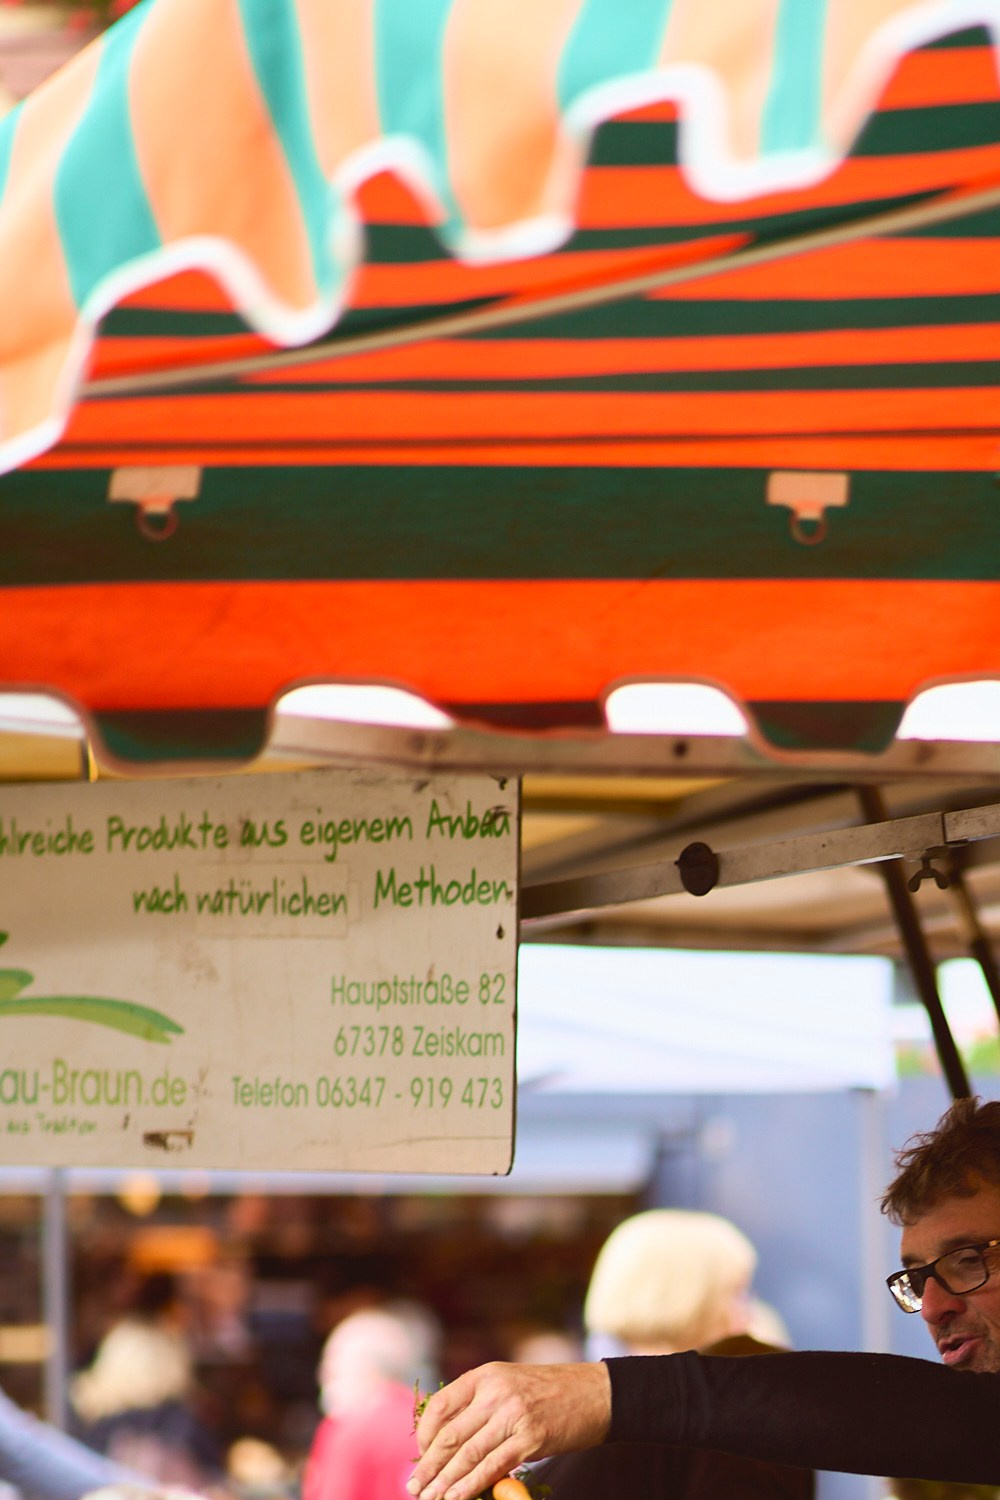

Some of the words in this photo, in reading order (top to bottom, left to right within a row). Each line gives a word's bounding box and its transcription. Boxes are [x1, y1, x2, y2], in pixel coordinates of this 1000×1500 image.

[107, 810, 229, 853] Produkte
[240, 818, 288, 848] aus
[300, 807, 412, 862] eigenem
[426, 799, 510, 841] Anbau
[133, 872, 188, 913] nach
[197, 875, 347, 916] natürlichen
[373, 864, 509, 909] Methoden
[331, 973, 469, 1011] Hauptstraße
[479, 973, 506, 1005] 82
[333, 1026, 403, 1056] 67378
[412, 1026, 505, 1056] Zeiskam
[232, 1076, 309, 1107] Telefon
[316, 1076, 386, 1108] 06347
[410, 1077, 452, 1108] 919
[461, 1077, 504, 1109] 473
